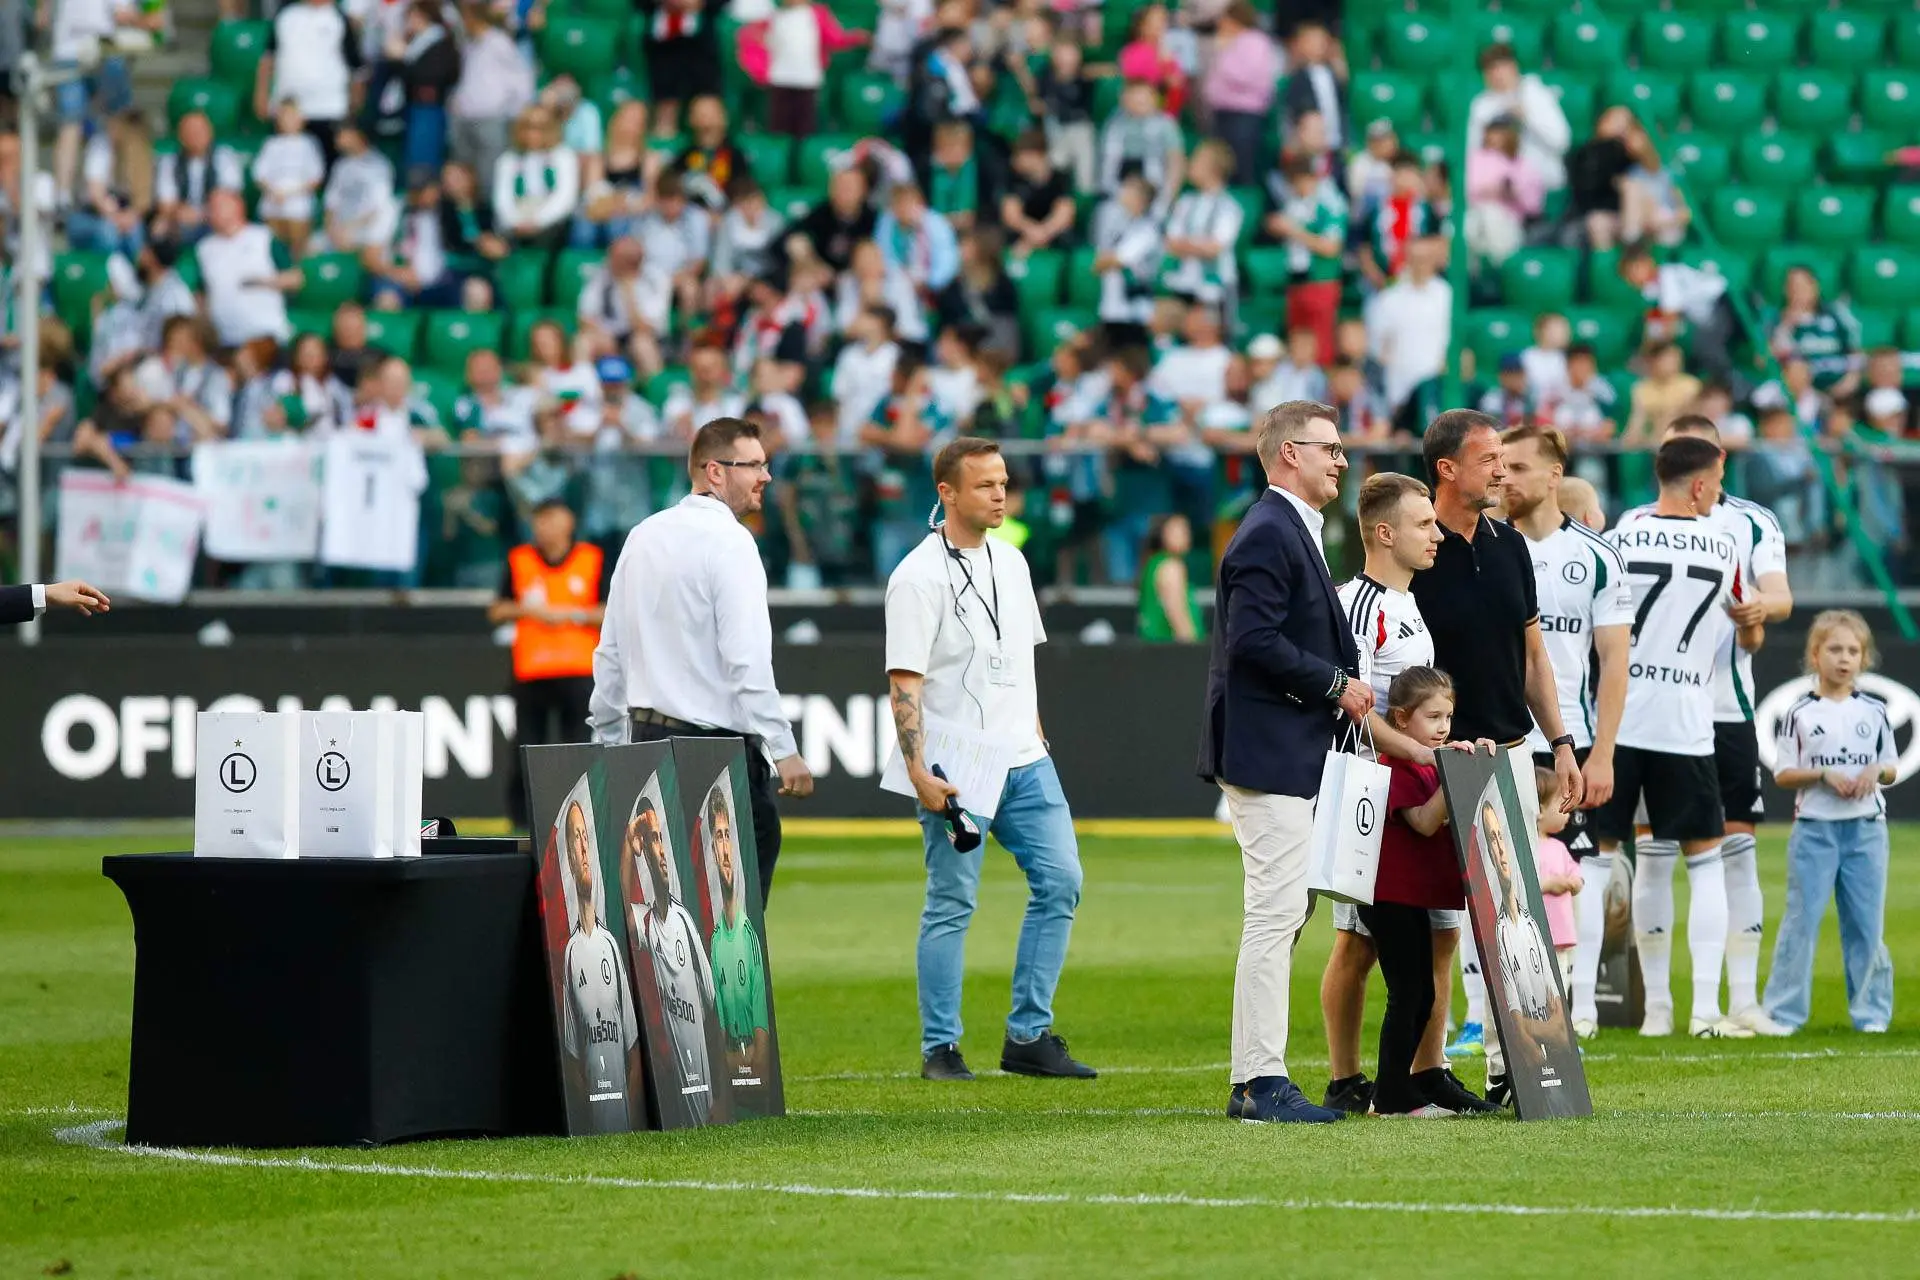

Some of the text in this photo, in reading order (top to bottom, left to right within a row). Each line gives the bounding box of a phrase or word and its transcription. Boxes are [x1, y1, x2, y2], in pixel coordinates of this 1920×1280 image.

[1627, 561, 1723, 653] 77
[1629, 663, 1700, 686] ORTUNA
[585, 1019, 619, 1046] lus500
